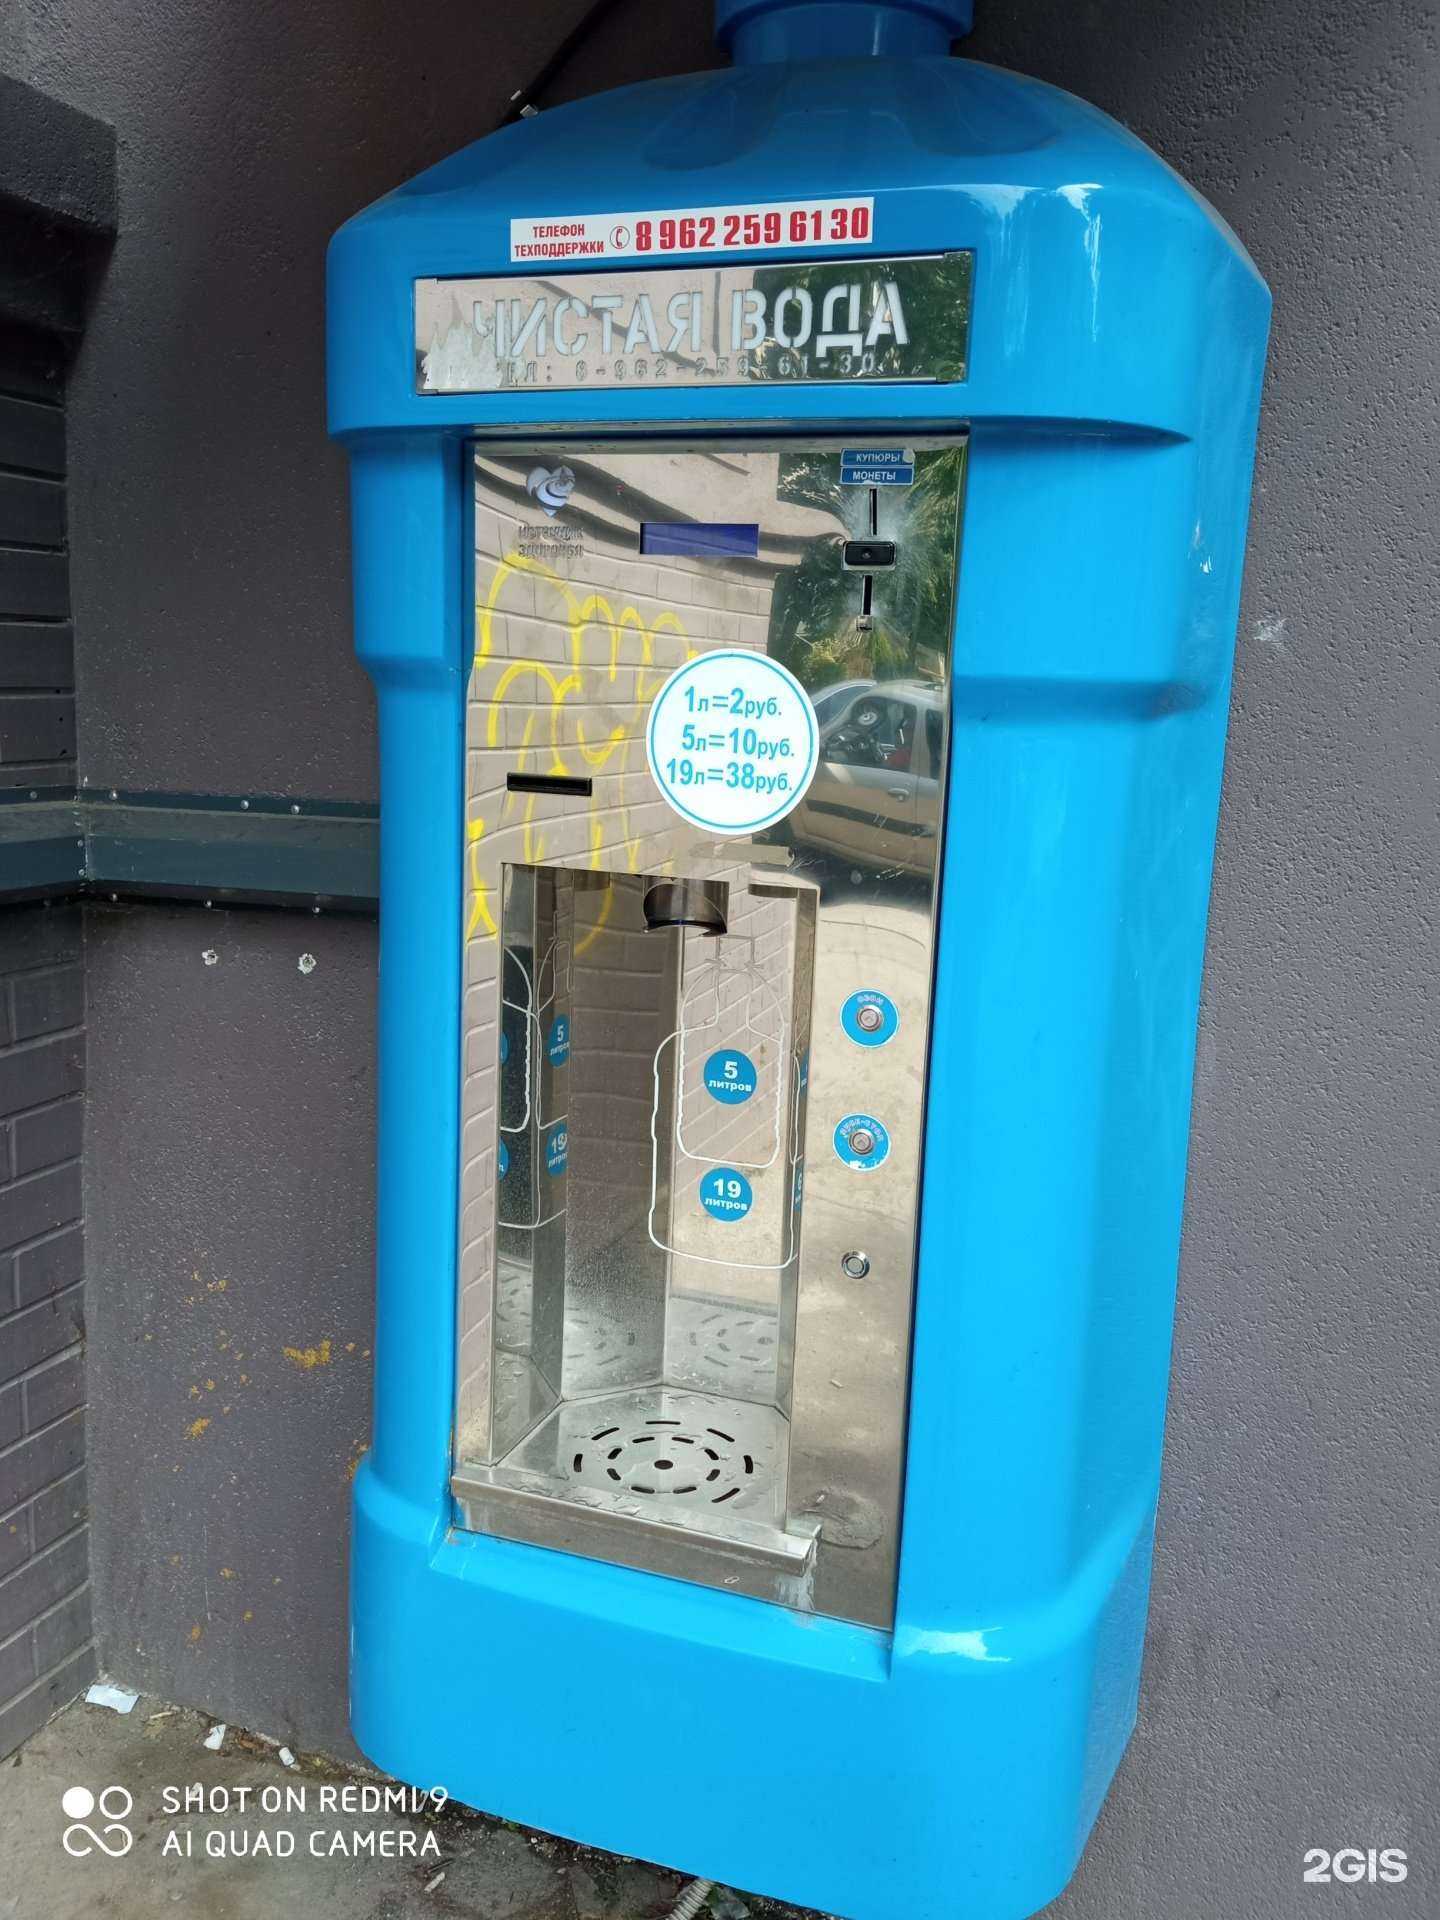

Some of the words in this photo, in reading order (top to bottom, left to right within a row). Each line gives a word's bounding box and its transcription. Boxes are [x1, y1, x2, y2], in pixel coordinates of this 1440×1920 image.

[533, 224, 585, 238] ТЕЛЕФОН
[515, 241, 604, 257] ТЕХПОДДЕРЖКИ
[473, 290, 701, 358] ЧИСТАЯ
[732, 281, 909, 358] ВОДА
[856, 453, 900, 463] КУПЮРЫ
[852, 471, 896, 481] МОНЕТЫ
[684, 686, 782, 719] 1л=2руб.
[682, 724, 795, 760] 5л=10руб.
[666, 758, 793, 794] 19л=38руб.
[723, 1060, 738, 1079] 5
[708, 1079, 752, 1093] литров
[713, 1178, 742, 1198] 19
[704, 1197, 748, 1211] литров
